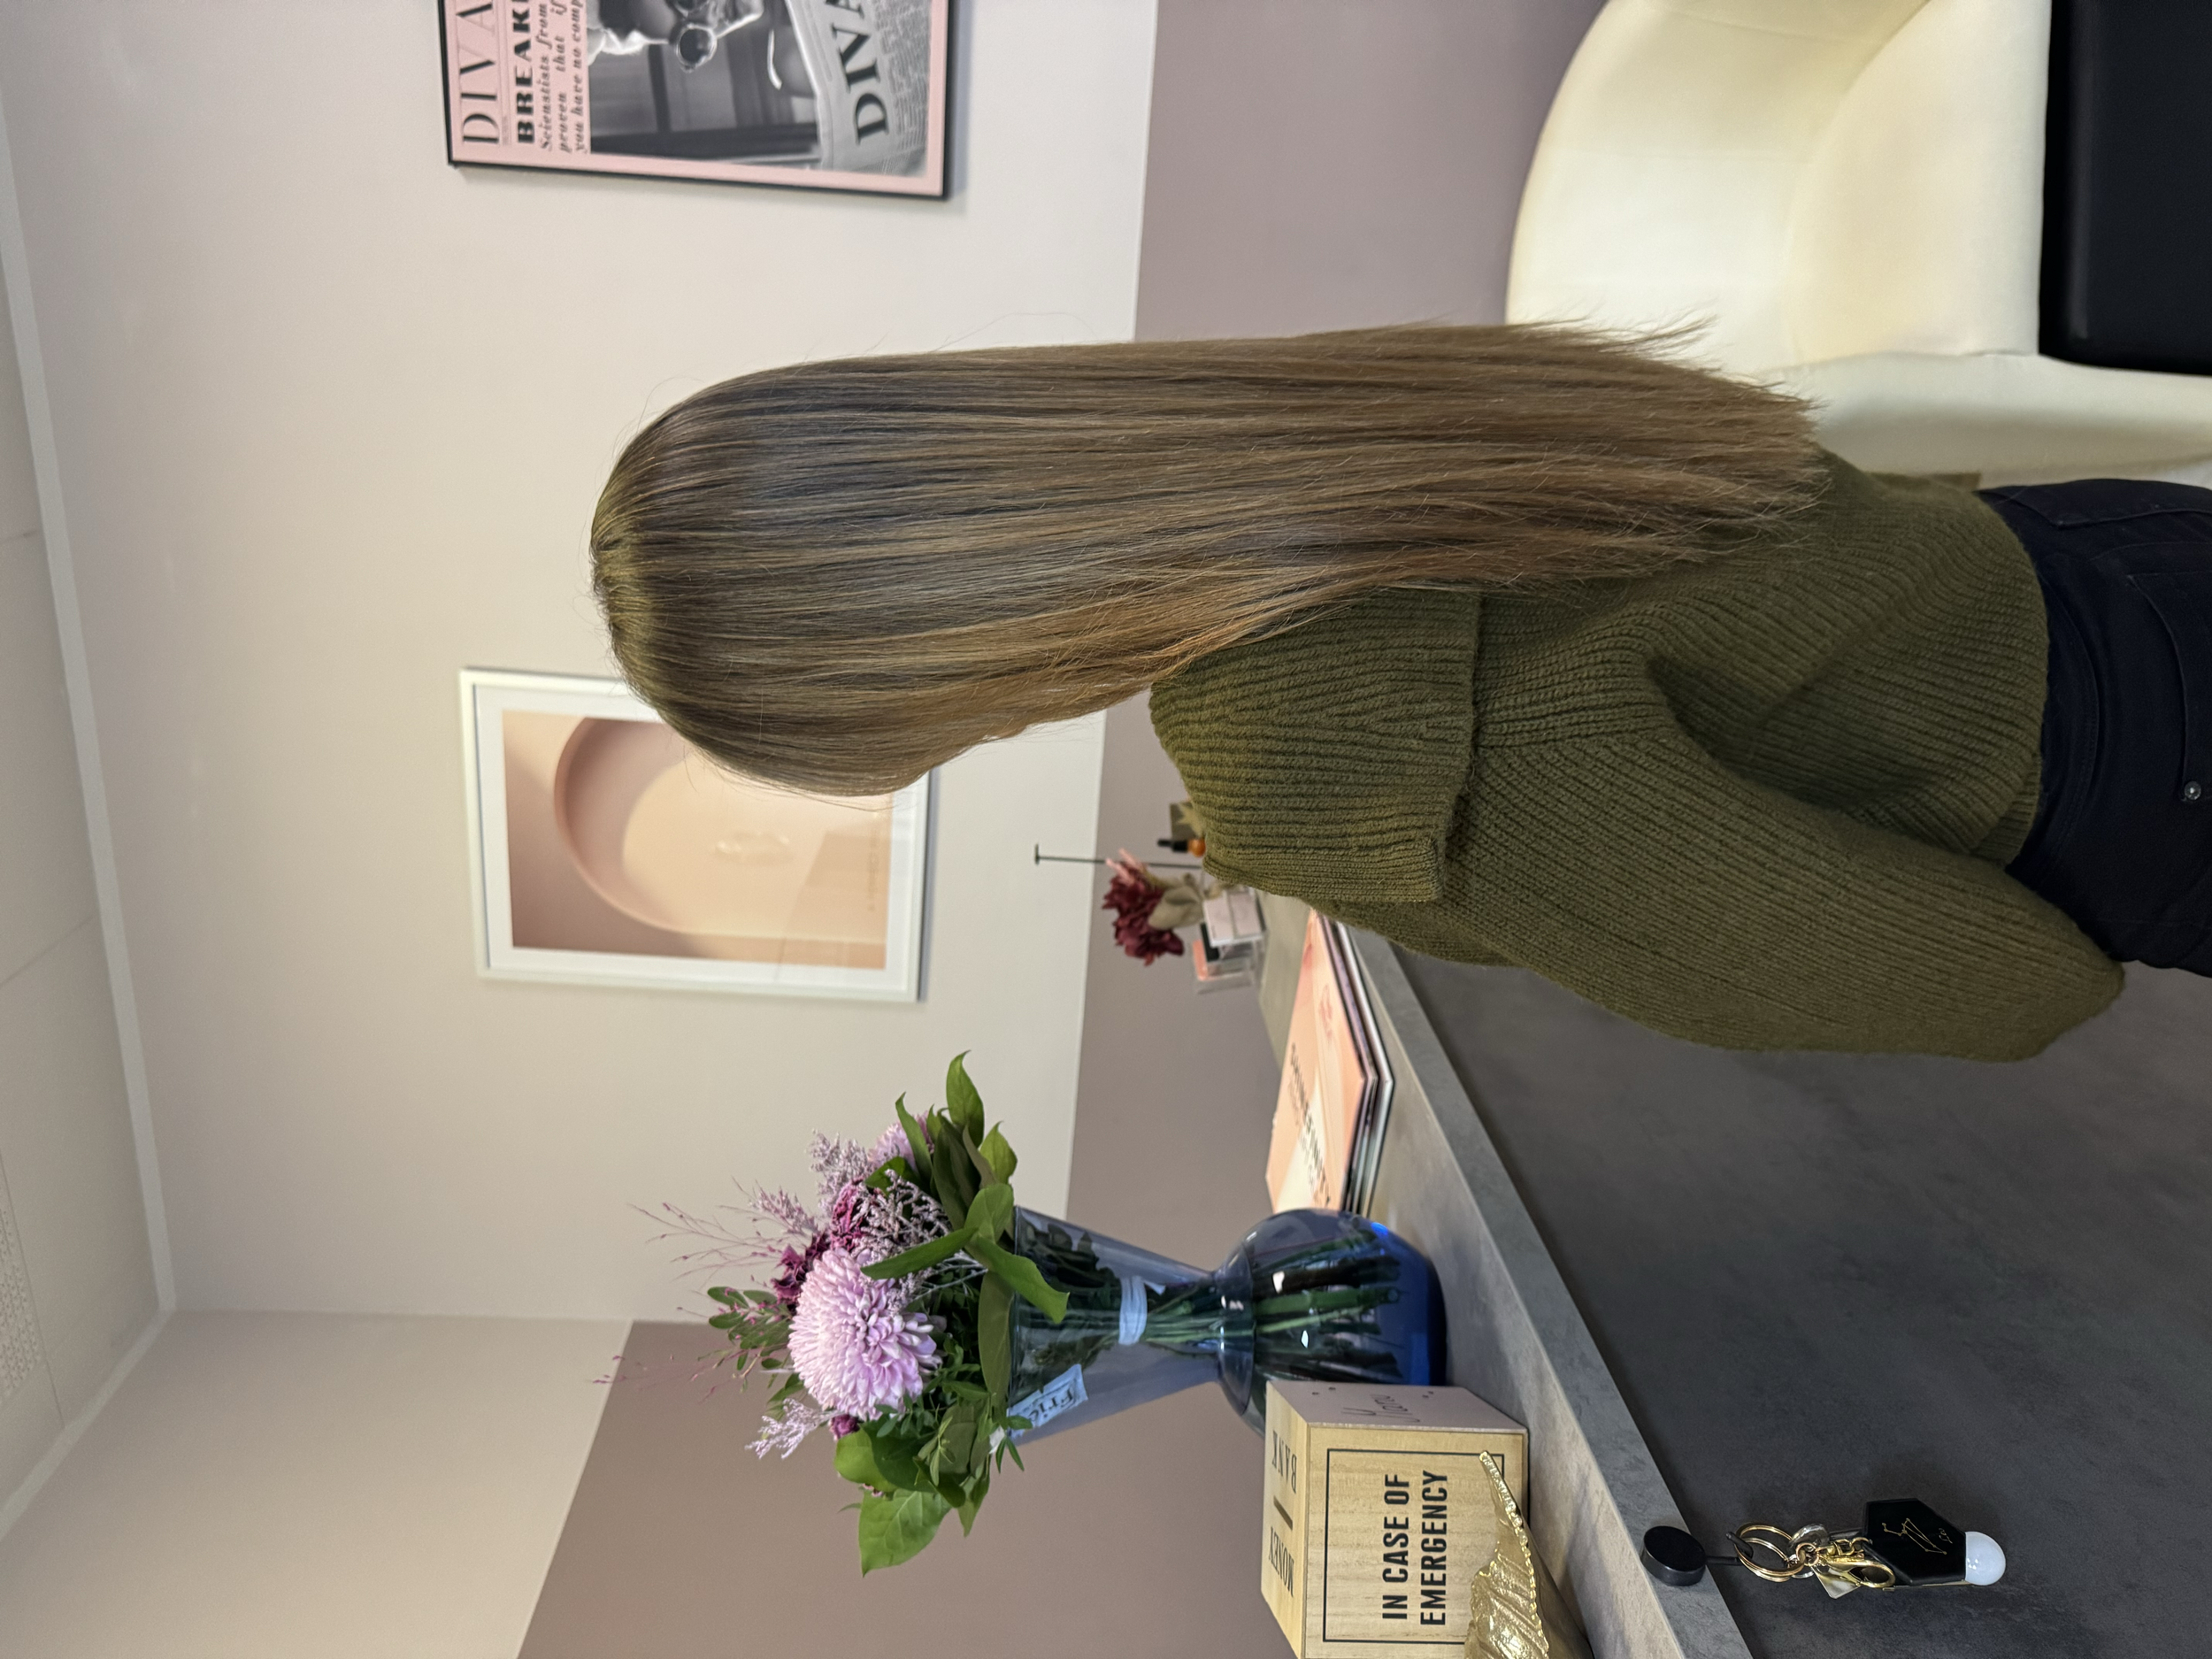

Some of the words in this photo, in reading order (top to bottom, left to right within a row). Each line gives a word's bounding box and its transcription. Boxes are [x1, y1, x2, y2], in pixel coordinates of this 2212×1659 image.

[535, 4, 552, 50] from
[456, 0, 499, 143] DIVA
[553, 35, 566, 73] that
[573, 47, 583, 69] no
[571, 73, 584, 117] have
[558, 92, 573, 153] proven
[575, 121, 588, 153] you
[1271, 1429, 1297, 1494] BANK
[1384, 1473, 1410, 1505] OF
[1382, 1516, 1409, 1584] CASE
[1419, 1470, 1448, 1626] EMERGENCY
[1938, 1527, 1953, 1544] Leo
[1268, 1525, 1294, 1598] MONEY
[1382, 1594, 1409, 1620] IN
